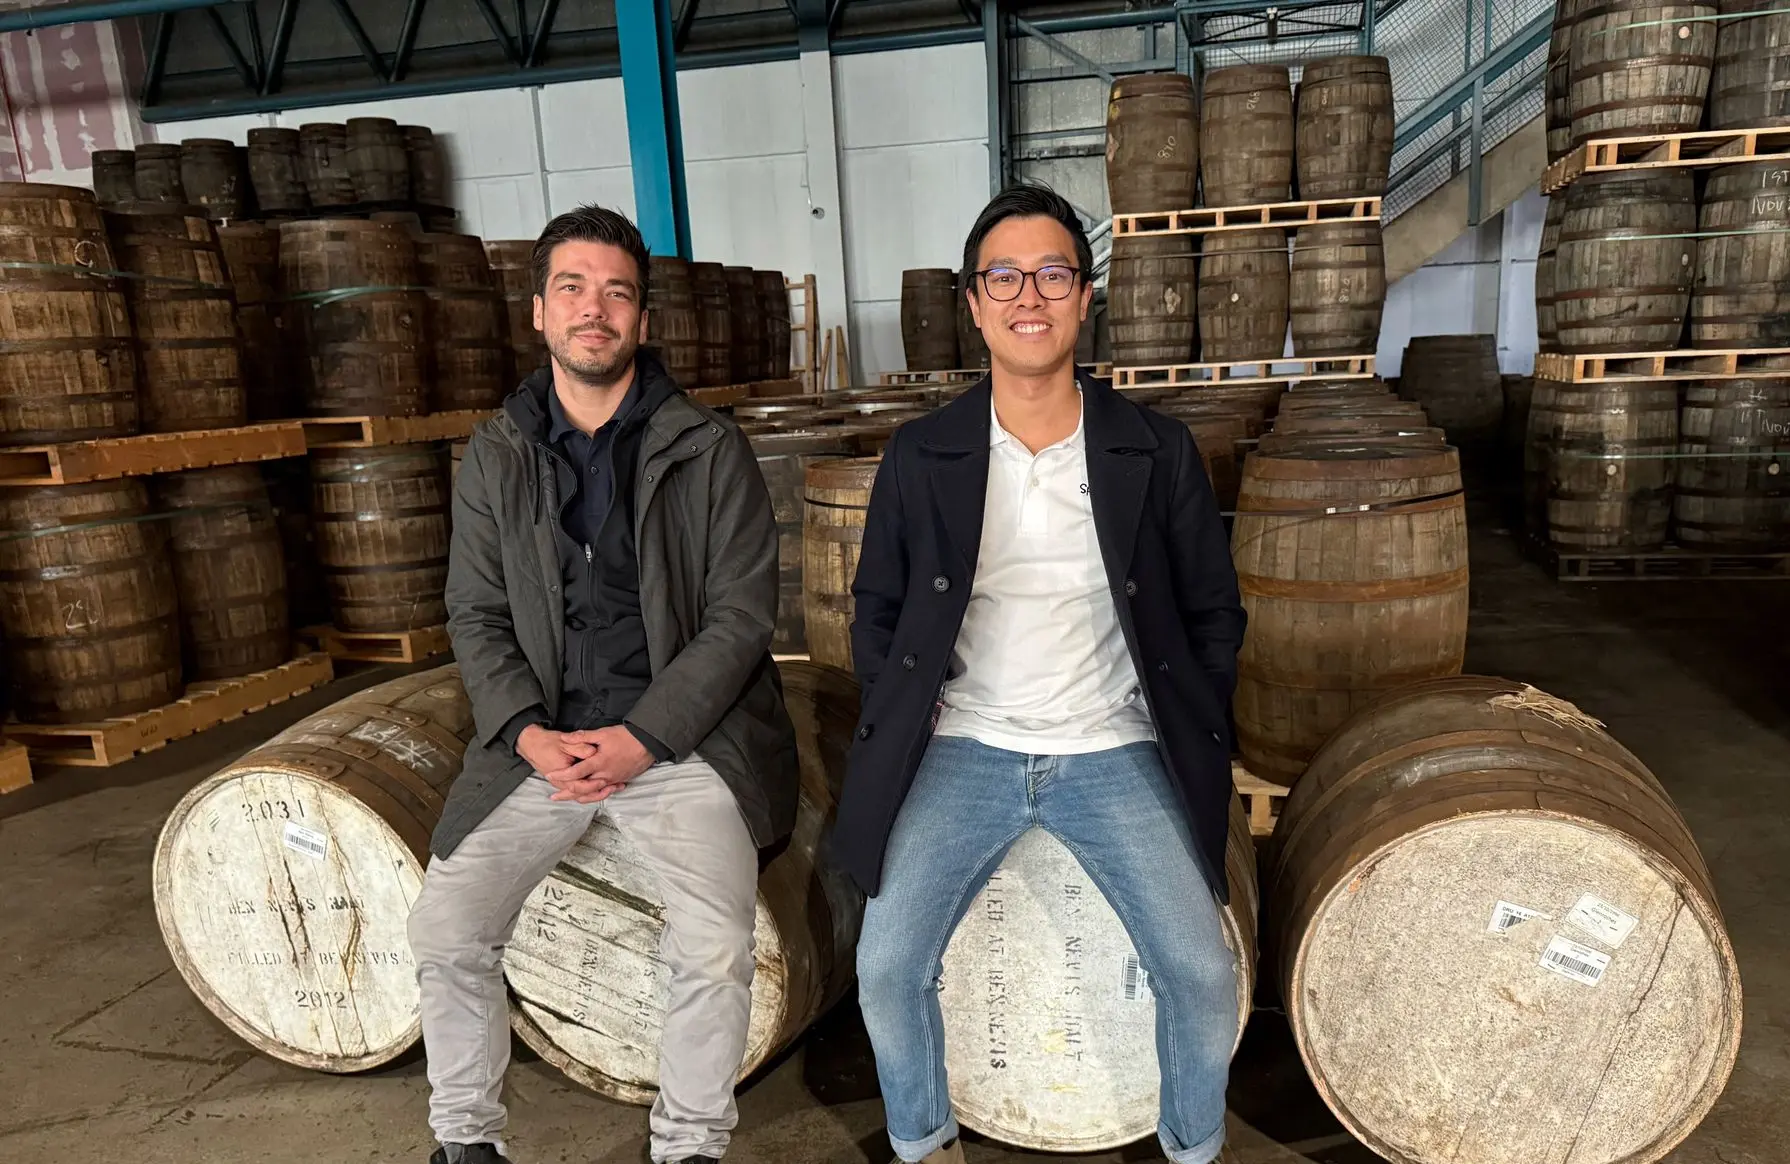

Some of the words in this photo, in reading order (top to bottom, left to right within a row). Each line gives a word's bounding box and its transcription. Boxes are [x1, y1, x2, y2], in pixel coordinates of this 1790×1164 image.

[241, 799, 306, 823] 2031
[988, 935, 1005, 956] AT
[1064, 935, 1083, 996] NEVIS
[294, 989, 348, 1009] 2012
